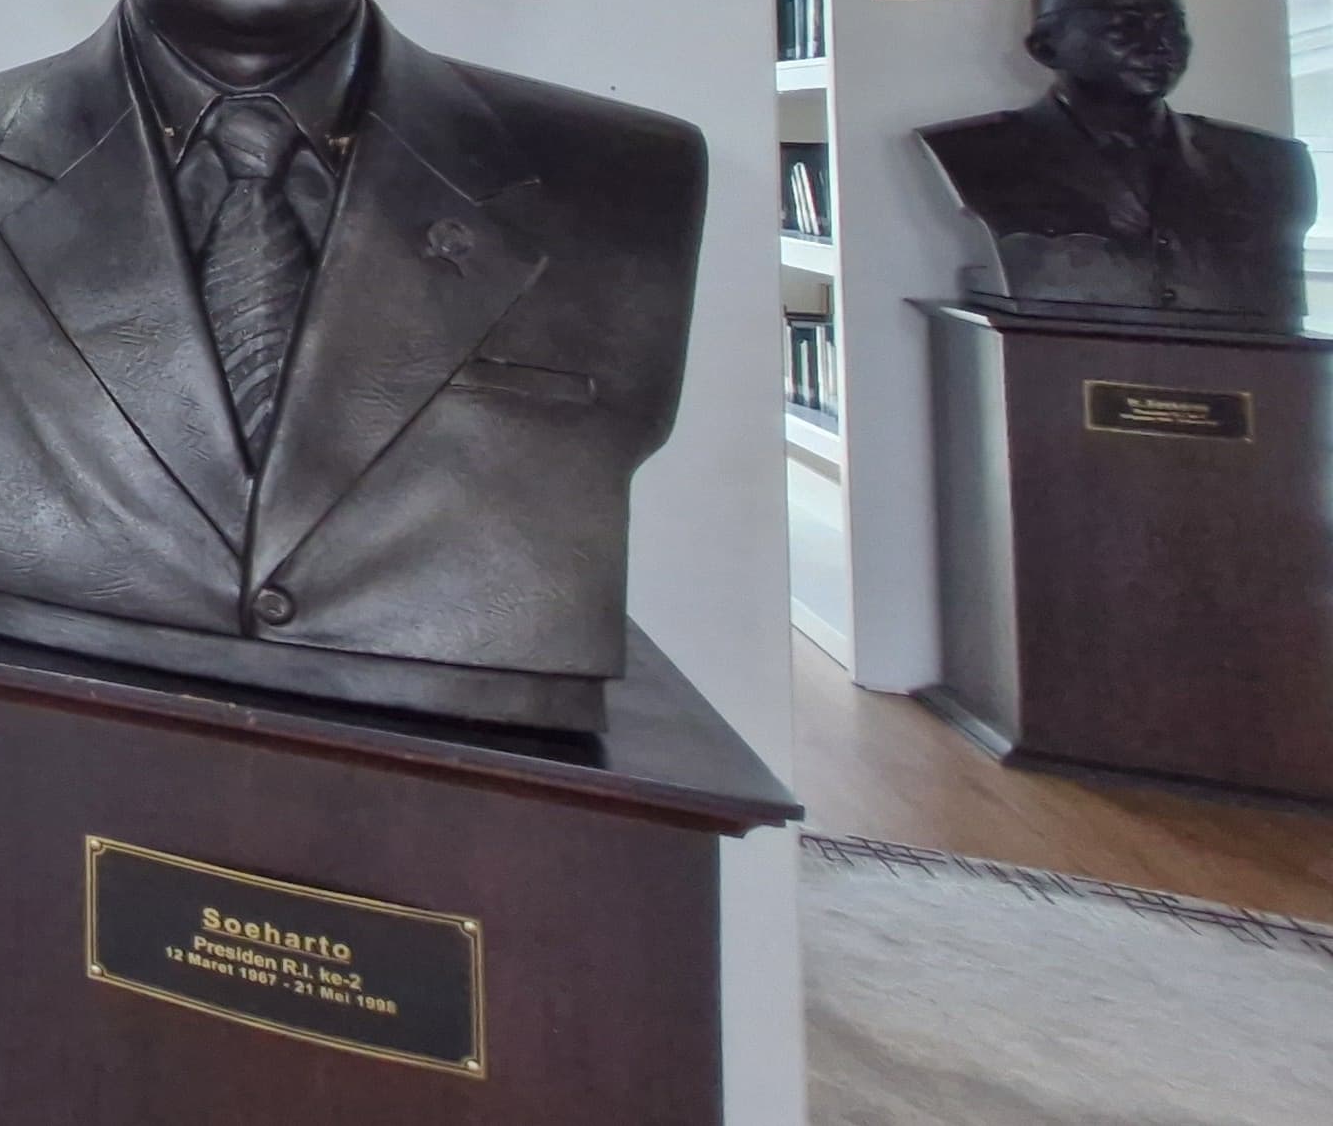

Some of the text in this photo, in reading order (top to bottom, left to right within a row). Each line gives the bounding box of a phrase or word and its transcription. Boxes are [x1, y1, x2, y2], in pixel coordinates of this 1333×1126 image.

[202, 907, 352, 961] Soeharto
[165, 946, 185, 962] 12
[238, 966, 278, 987] 1967
[294, 980, 314, 995] 21
[319, 985, 351, 1004] Mei
[193, 935, 363, 992] Presiden R.I. ke-2
